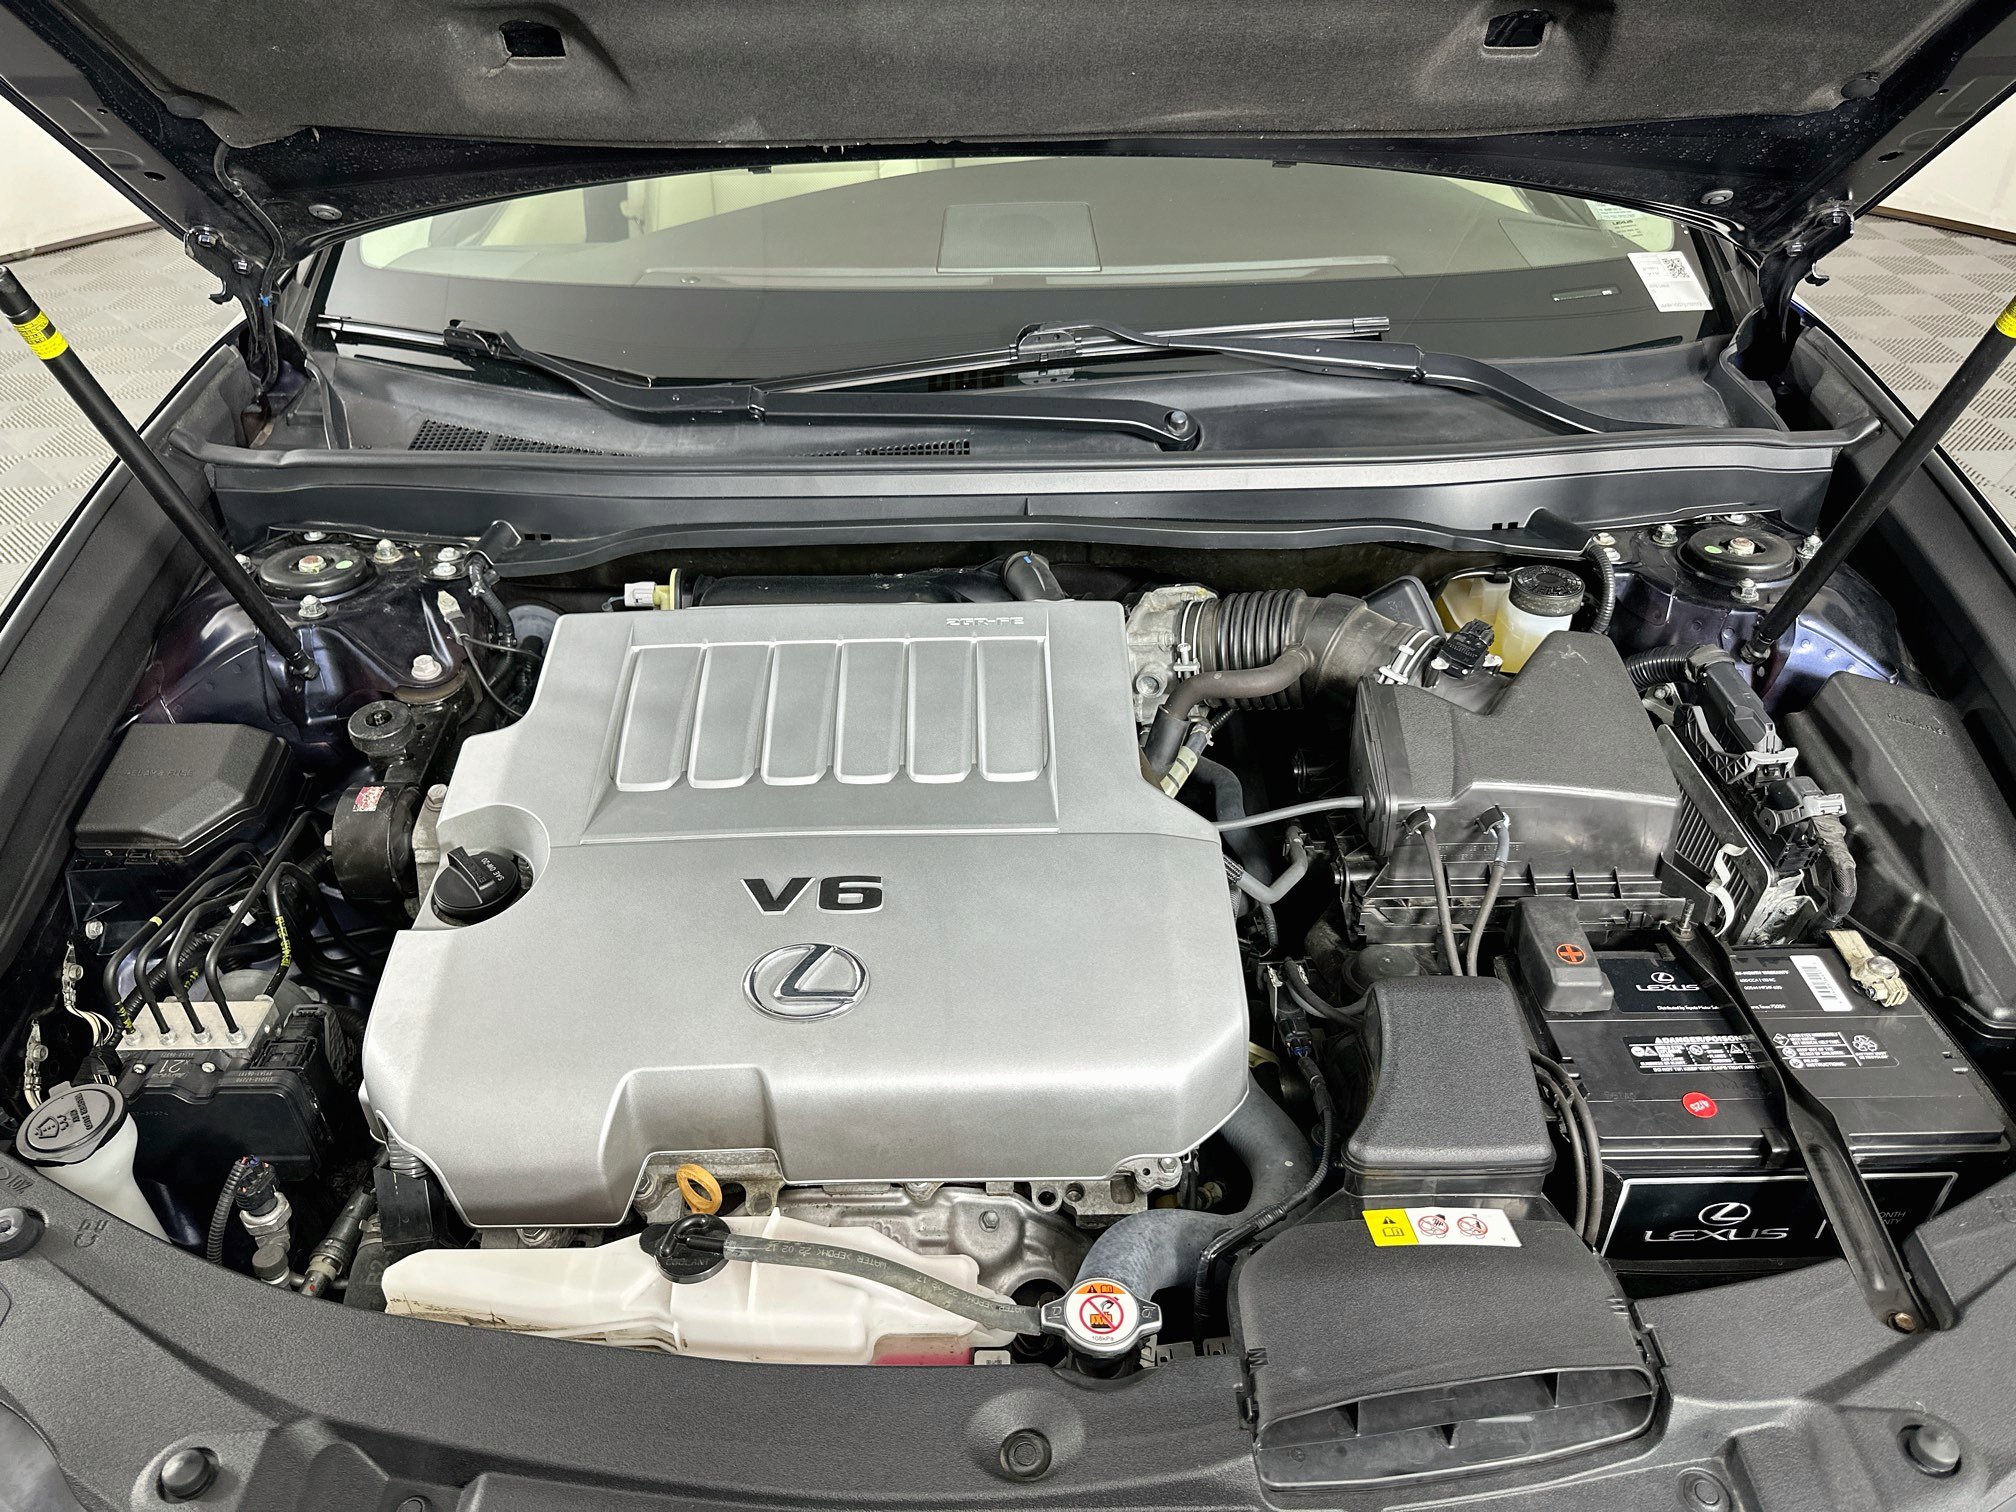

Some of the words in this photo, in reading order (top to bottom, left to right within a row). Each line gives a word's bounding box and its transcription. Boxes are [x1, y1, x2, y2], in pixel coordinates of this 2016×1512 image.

[740, 875, 884, 916] V6
[1635, 984, 1700, 992] LEXUS
[1643, 1228, 1790, 1242] LEXUS
